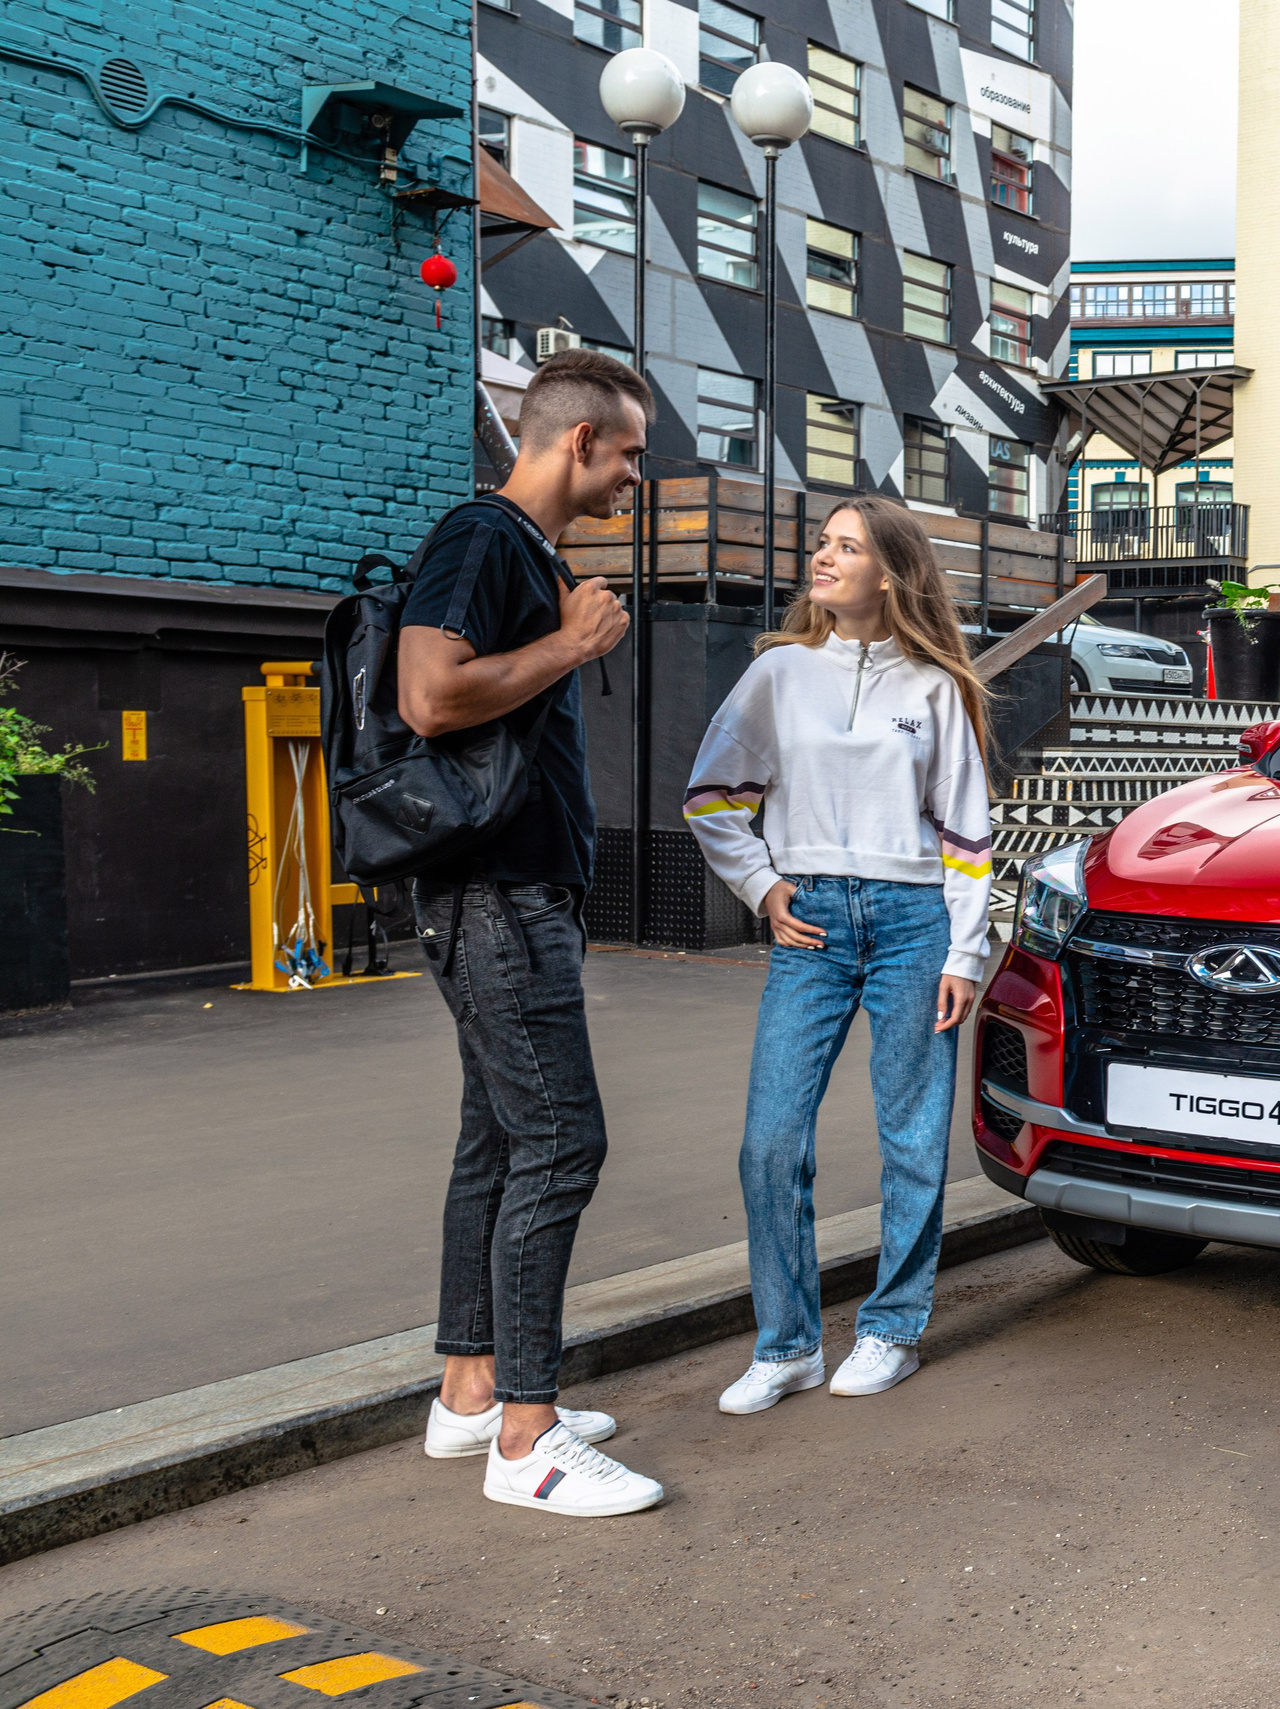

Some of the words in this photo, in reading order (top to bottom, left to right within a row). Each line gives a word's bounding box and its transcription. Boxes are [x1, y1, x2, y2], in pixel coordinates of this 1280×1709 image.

[981, 86, 1030, 114] образование
[1003, 231, 1039, 255] культура
[979, 371, 1026, 414] архитектура
